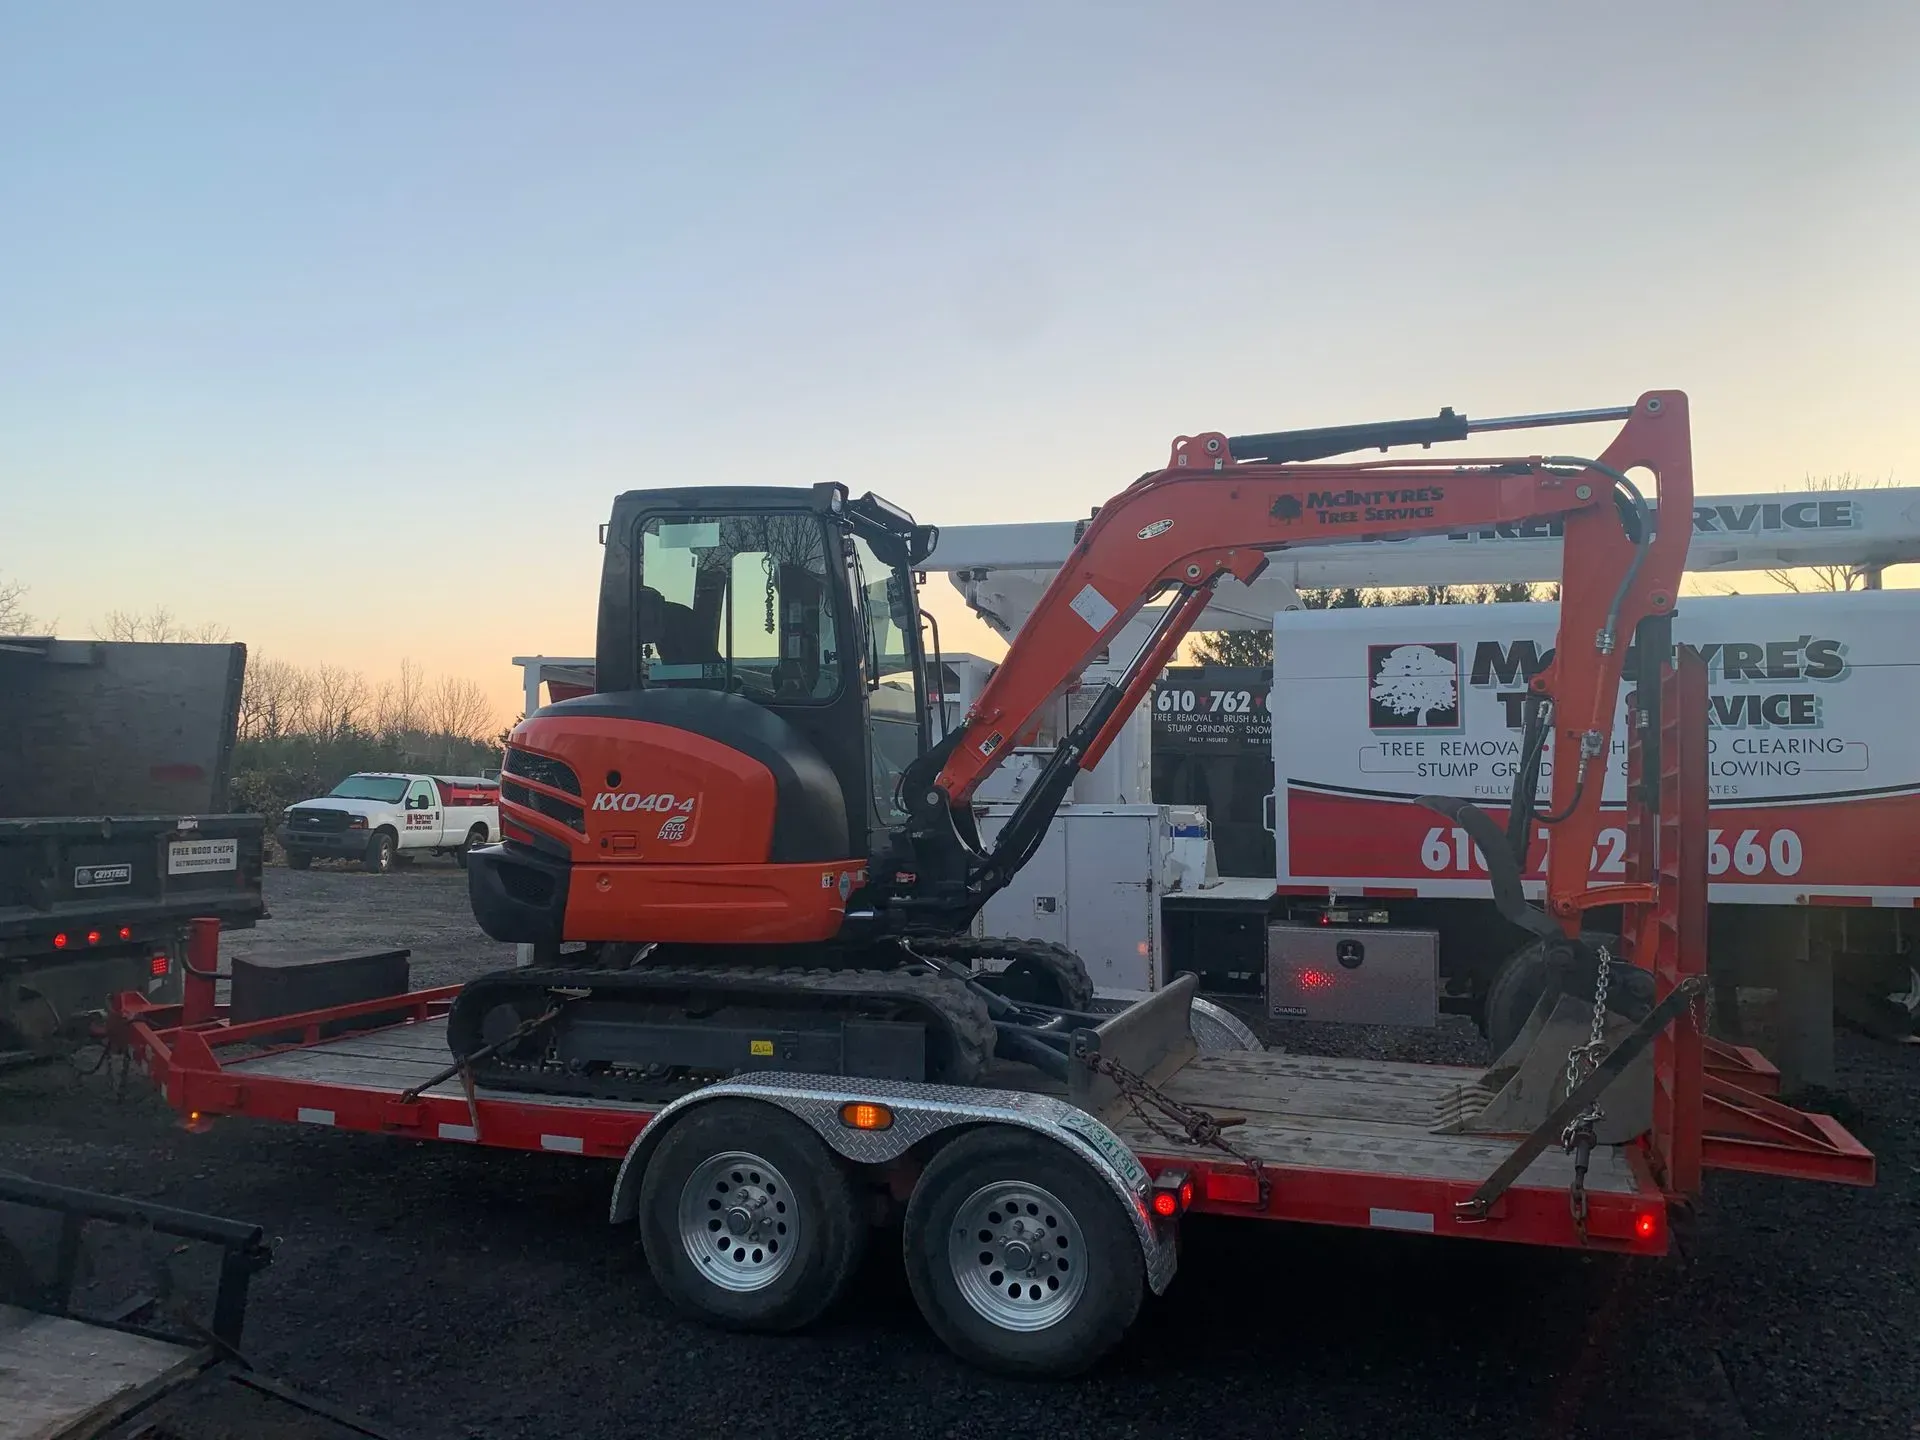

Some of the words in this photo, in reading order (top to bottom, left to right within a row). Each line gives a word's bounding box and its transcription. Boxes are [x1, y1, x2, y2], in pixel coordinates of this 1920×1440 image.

[1157, 690, 1196, 712] 610
[1209, 691, 1251, 713] 762
[1153, 713, 1172, 722] TREE
[1176, 714, 1212, 722] REMOVAL
[1223, 715, 1249, 723] BRUSH
[1167, 724, 1192, 732] STUMP
[1196, 725, 1234, 734] GRINDING
[1380, 742, 1425, 756] TREE
[1441, 741, 1519, 756] REMOVA
[1732, 738, 1844, 754] CLEARING
[1417, 763, 1478, 777] STUMP
[1711, 761, 1801, 776] LOWING
[1475, 785, 1510, 794] FULLY
[592, 792, 694, 812] KX040-4
[665, 822, 685, 831] eco
[657, 831, 683, 840] PLUS
[172, 846, 189, 856] FREE
[191, 847, 211, 855] WOOD
[213, 845, 234, 854] CHIPS
